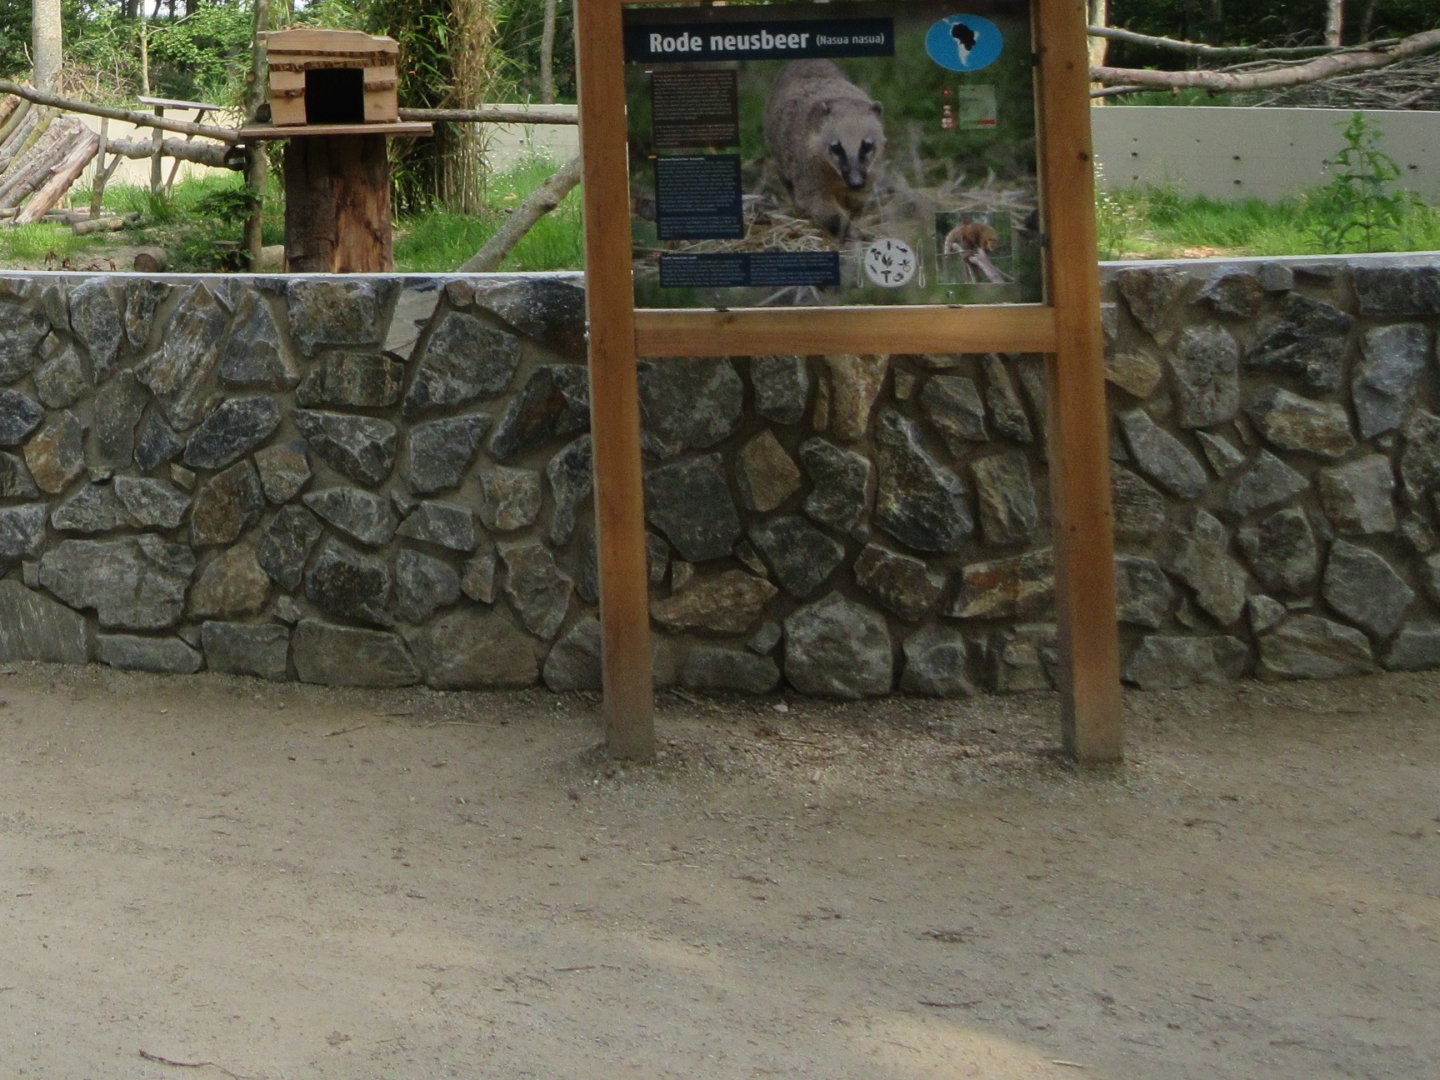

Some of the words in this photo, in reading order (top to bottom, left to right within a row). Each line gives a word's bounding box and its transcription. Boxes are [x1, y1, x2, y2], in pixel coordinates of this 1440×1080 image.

[649, 32, 702, 53] Rode
[710, 29, 810, 51] neusbeer
[816, 34, 849, 47] (Nasua
[852, 32, 885, 45] nasua)
